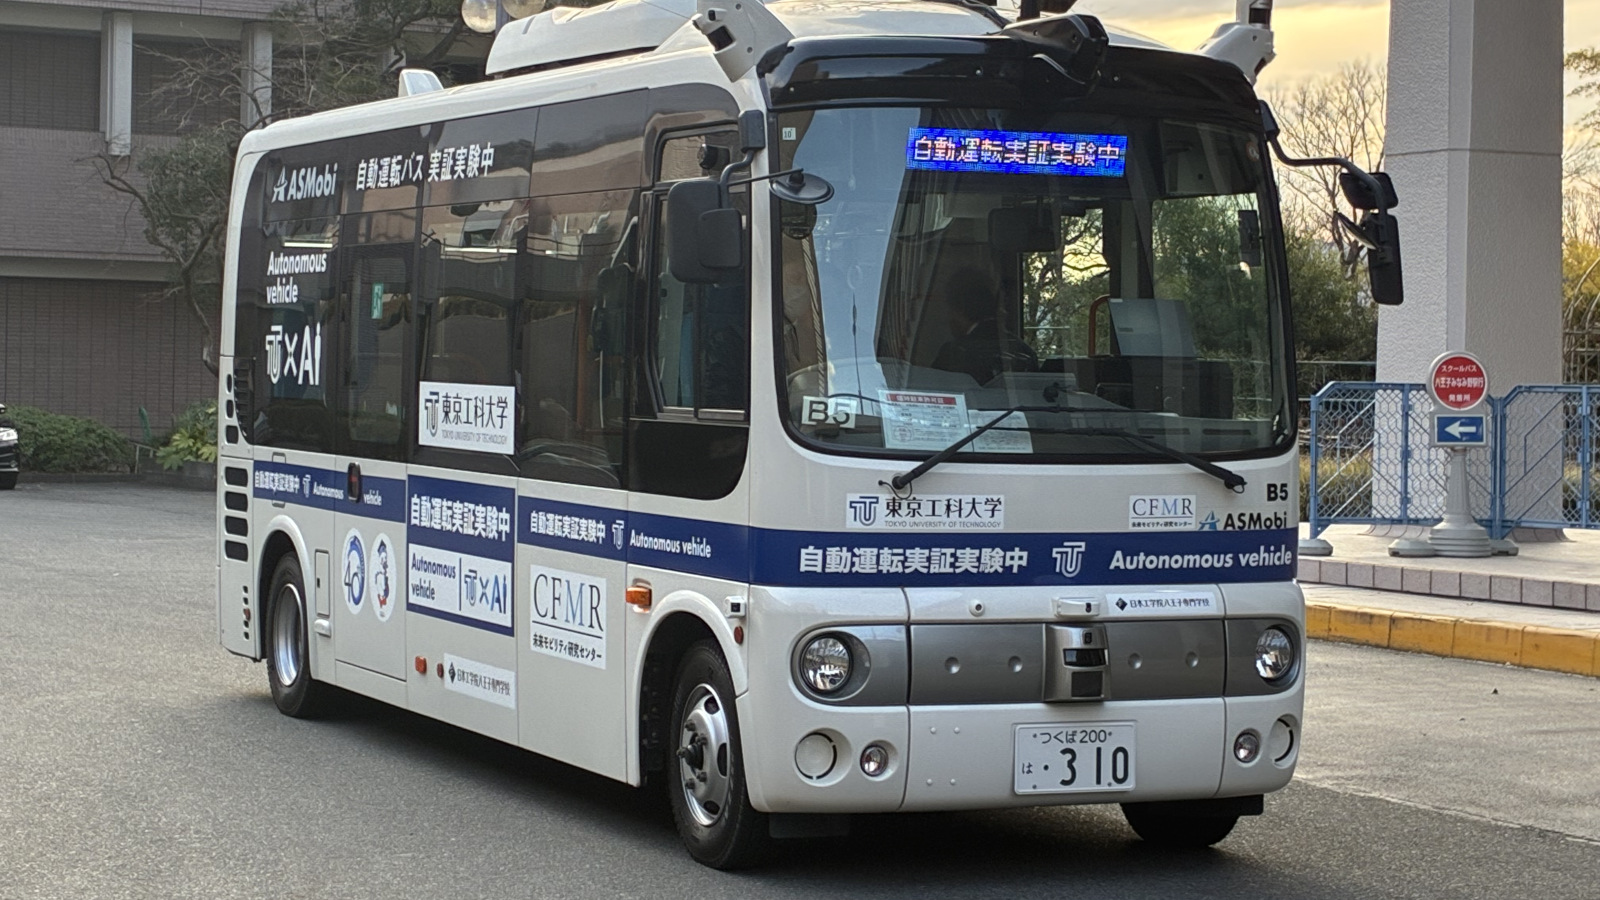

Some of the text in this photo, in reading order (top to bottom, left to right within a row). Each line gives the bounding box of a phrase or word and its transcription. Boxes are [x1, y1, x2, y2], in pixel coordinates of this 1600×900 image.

[914, 135, 1120, 167] 自動運転実証実験中
[356, 142, 494, 191] 自動運転バス 実証実験中
[287, 163, 338, 202] ASMobi
[267, 252, 327, 276] Autonomous
[266, 277, 298, 304] vehicle
[442, 392, 508, 430] 東京工科大学
[808, 400, 850, 424] B5
[254, 470, 300, 494] 自動運転実証実験中
[313, 482, 382, 506] Autonomous vehicle
[1266, 483, 1288, 501] B5
[410, 494, 510, 542] 自動運転実証実験中
[885, 496, 1002, 518] 東京工科大学
[1132, 498, 1194, 516] CFMR
[1223, 511, 1287, 530] ASMobi
[530, 510, 606, 544] 自動運転実証実験中
[630, 530, 711, 558] Autonomous vehicle
[1109, 544, 1292, 570] Autonomous vehicle
[411, 553, 456, 580] Autonomous
[800, 546, 1028, 574] 自動運転実証実験中
[411, 580, 435, 601] vehicle
[533, 574, 604, 632] CFMR
[532, 632, 602, 662] 未来モビリティ研究センター
[1022, 762, 1034, 774] は
